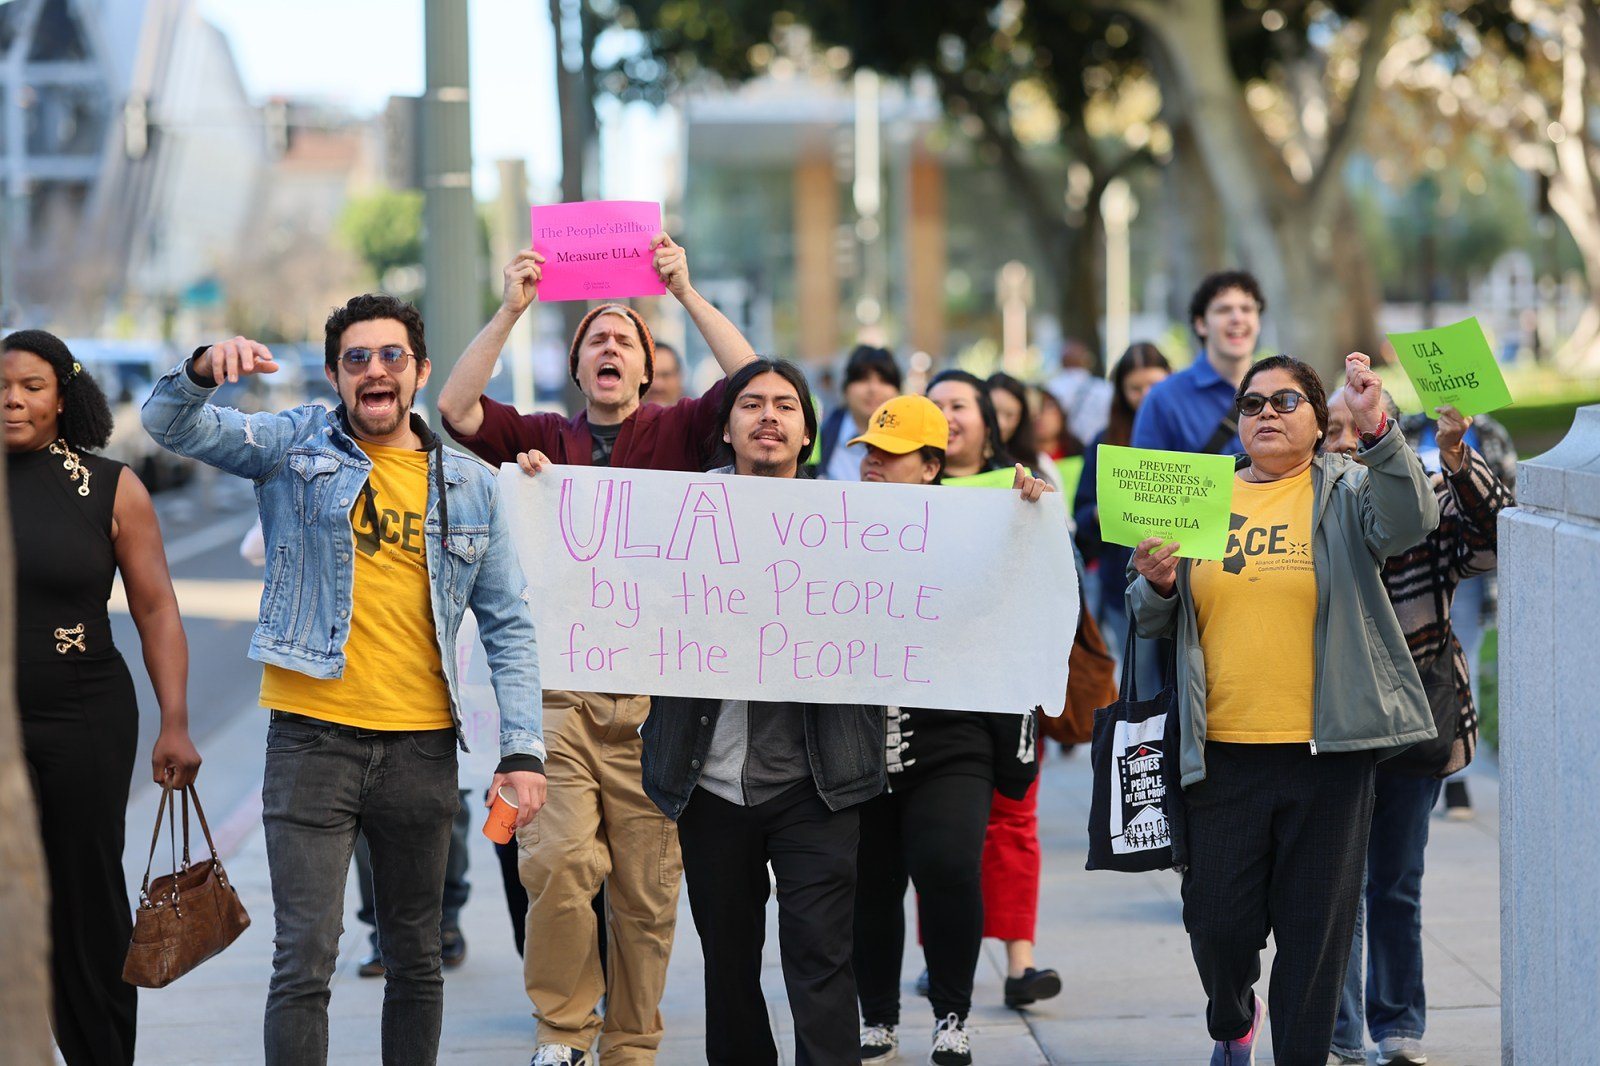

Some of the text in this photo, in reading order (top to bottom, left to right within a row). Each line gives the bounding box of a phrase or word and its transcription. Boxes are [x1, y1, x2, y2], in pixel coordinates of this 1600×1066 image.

[538, 227, 563, 239] The
[557, 247, 641, 263] Measure ULA
[1412, 341, 1444, 358] ULA
[1427, 360, 1442, 375] is
[1416, 371, 1480, 393] Working
[1139, 460, 1191, 474] PREVENT
[1112, 468, 1200, 485] HOMELESSNESS
[1119, 479, 1208, 497] DEVELOPER TAX
[1134, 492, 1177, 505] BREAKS
[559, 478, 929, 565] ULA voted
[1122, 511, 1200, 529] Measure ULA
[590, 560, 942, 627] by the PEOPLE
[560, 621, 930, 684] for the PEOPLE
[1130, 758, 1160, 775] HOMES
[1131, 774, 1163, 792] PEOPLE
[1134, 791, 1147, 802] FOR
